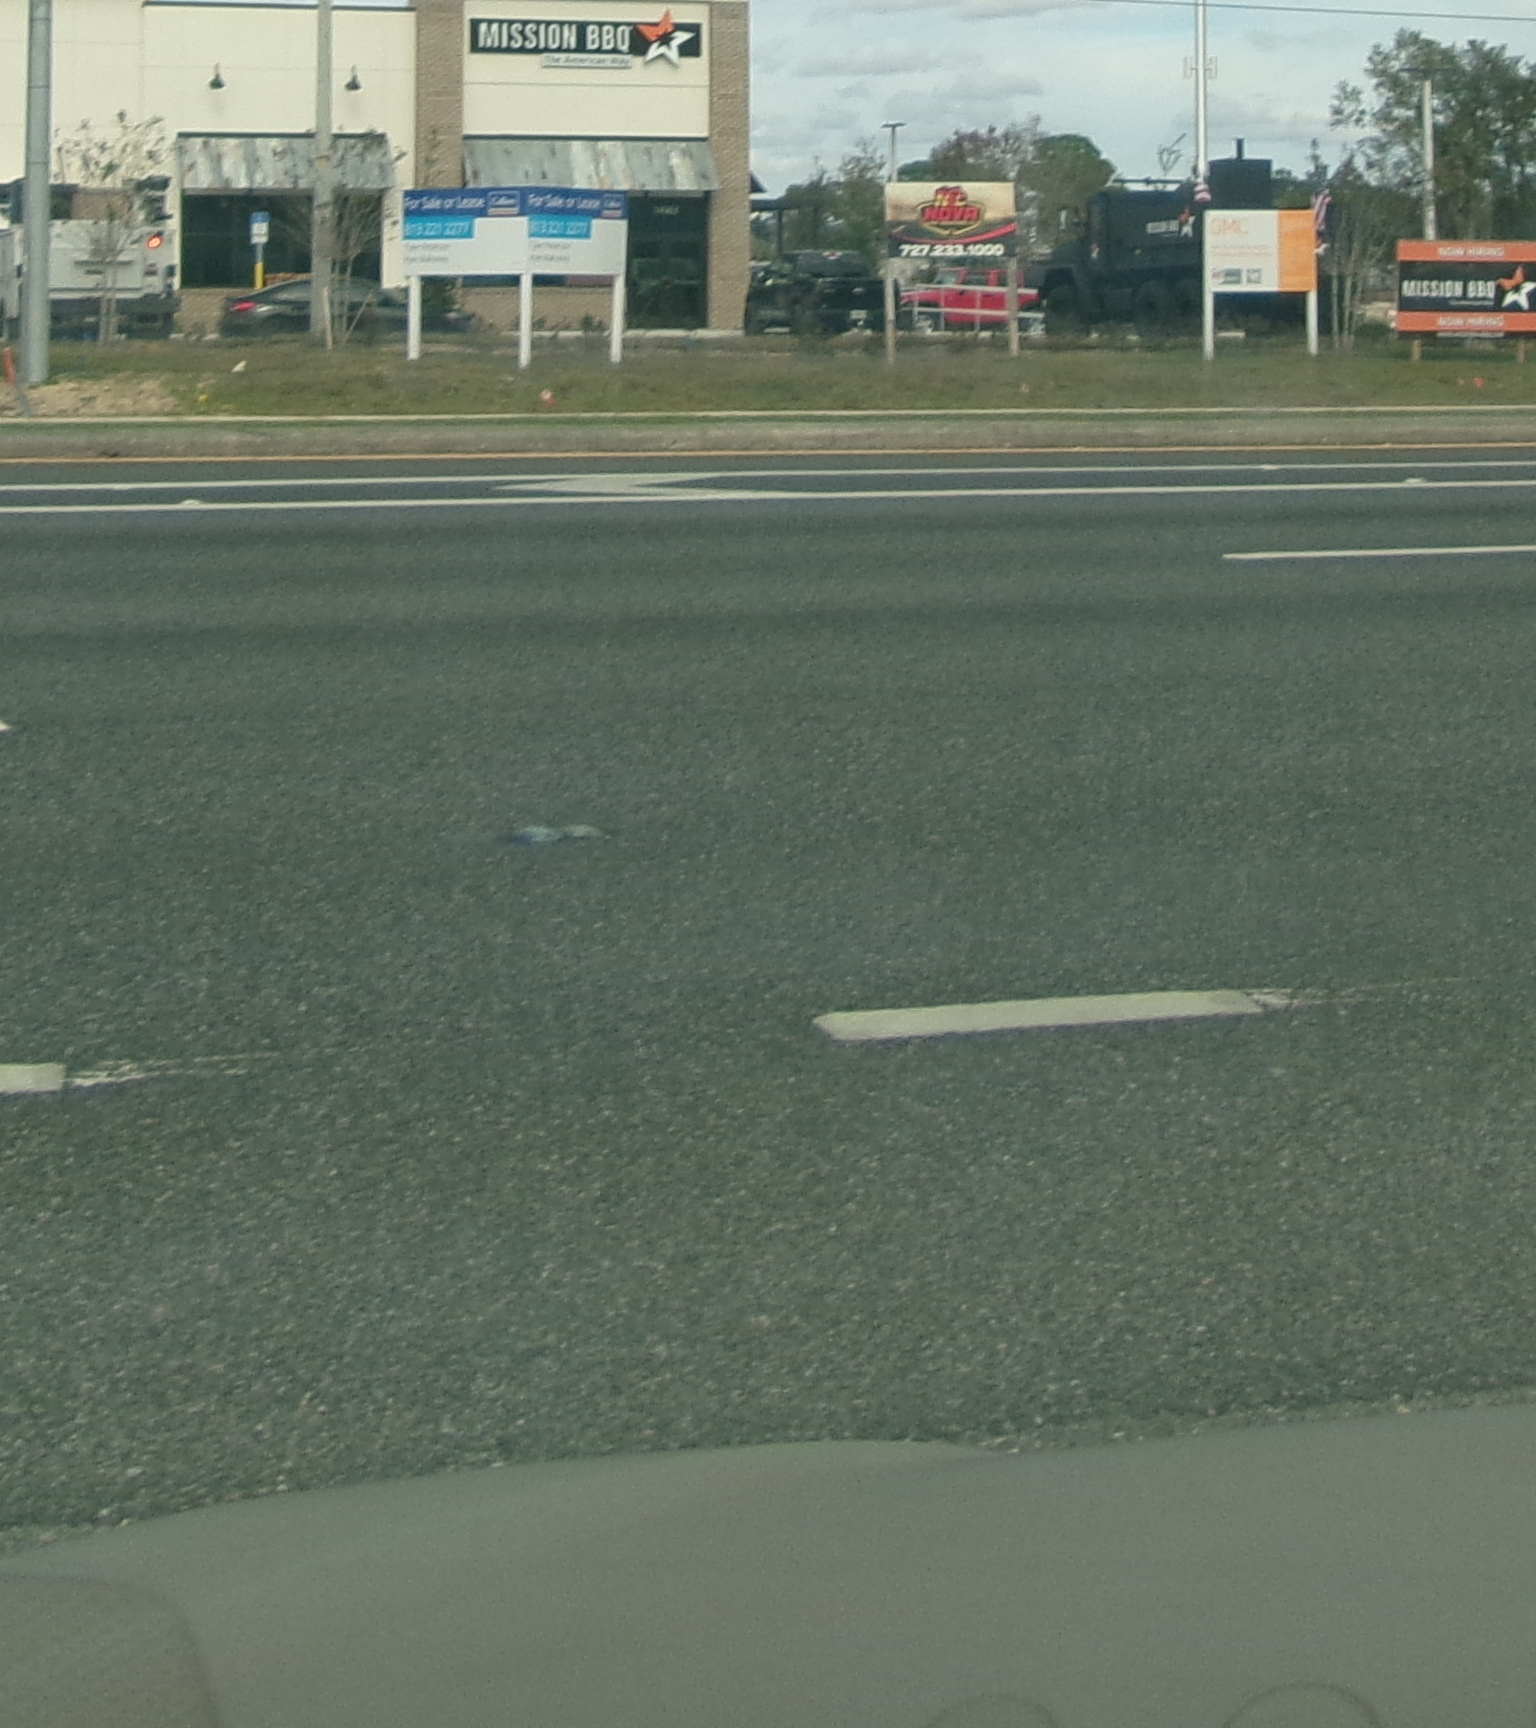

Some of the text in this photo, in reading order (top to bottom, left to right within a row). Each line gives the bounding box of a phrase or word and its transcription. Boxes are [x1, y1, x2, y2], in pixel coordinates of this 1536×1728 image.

[478, 21, 632, 53] MISSION BBQ
[404, 197, 420, 209] For
[422, 197, 441, 209] Sale
[457, 197, 484, 208] Lease
[528, 193, 543, 207] For
[545, 194, 563, 208] Sale
[577, 197, 600, 208] Lease
[1401, 279, 1463, 298] MISSION
